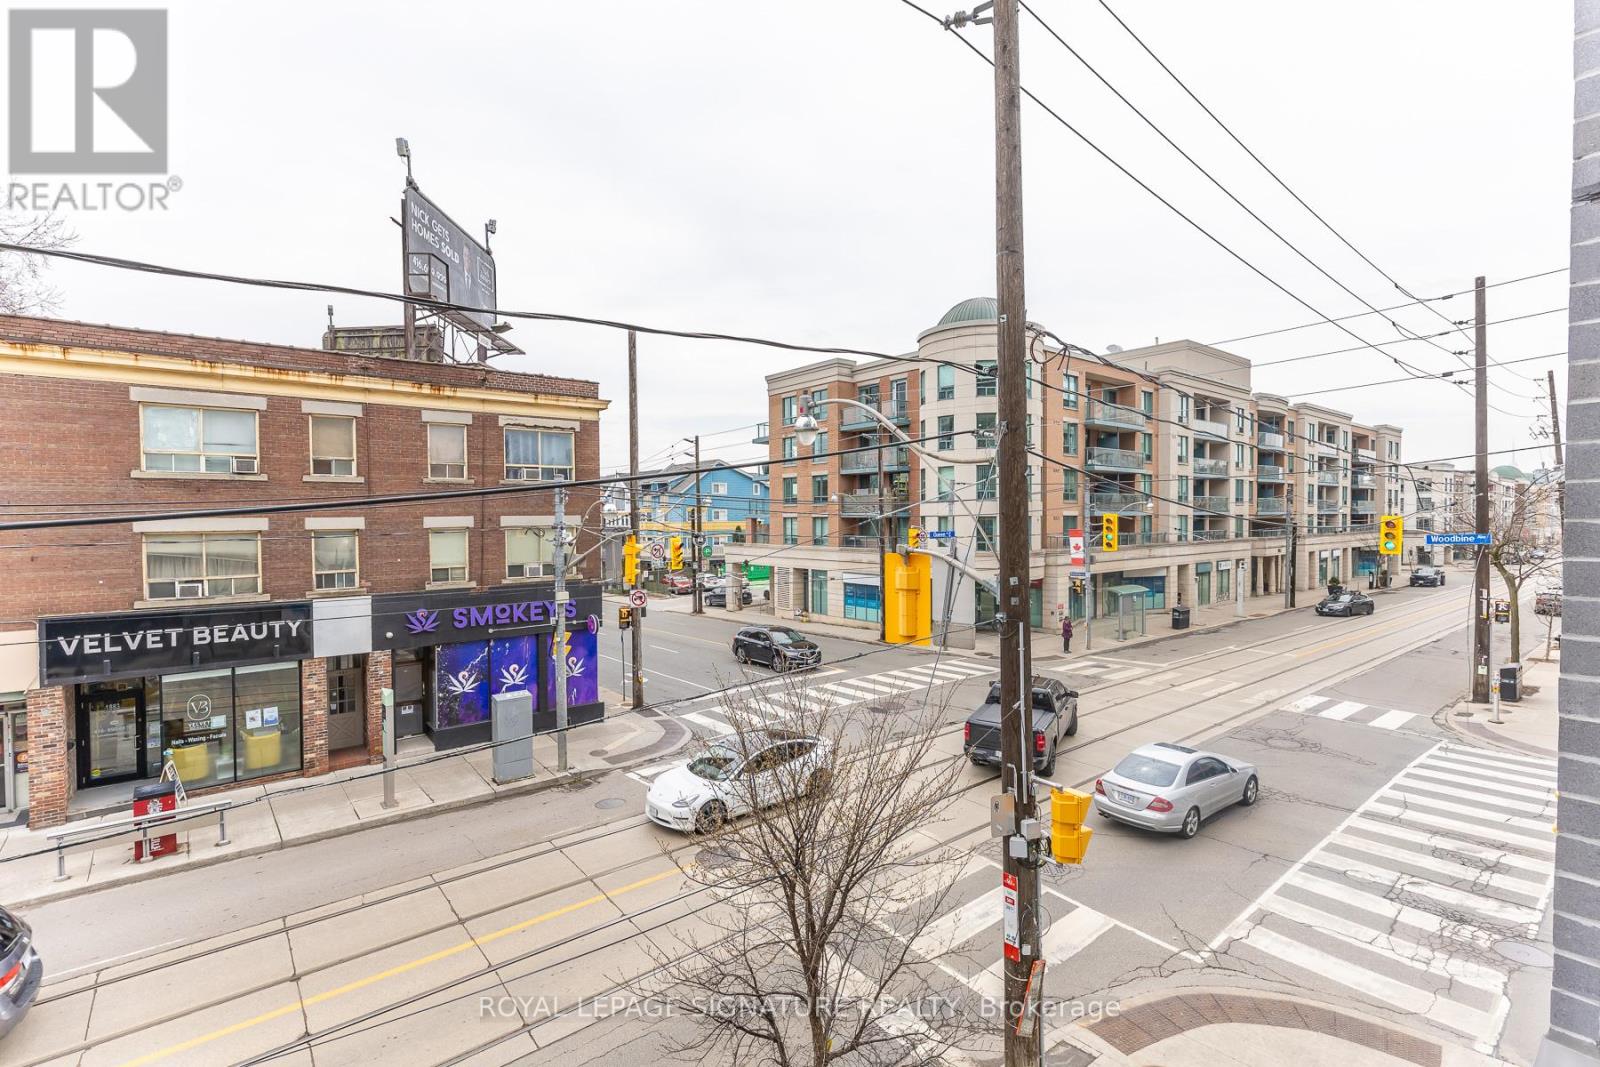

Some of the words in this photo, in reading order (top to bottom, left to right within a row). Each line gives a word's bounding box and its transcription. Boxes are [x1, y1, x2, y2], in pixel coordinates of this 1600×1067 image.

[411, 201, 430, 228] NICK
[431, 219, 450, 242] GETS
[411, 218, 440, 249] HOMES
[441, 242, 460, 264] SOLD
[1430, 534, 1475, 543] Woodbine
[57, 628, 184, 657] VELVET
[193, 619, 303, 646] BEAUTY
